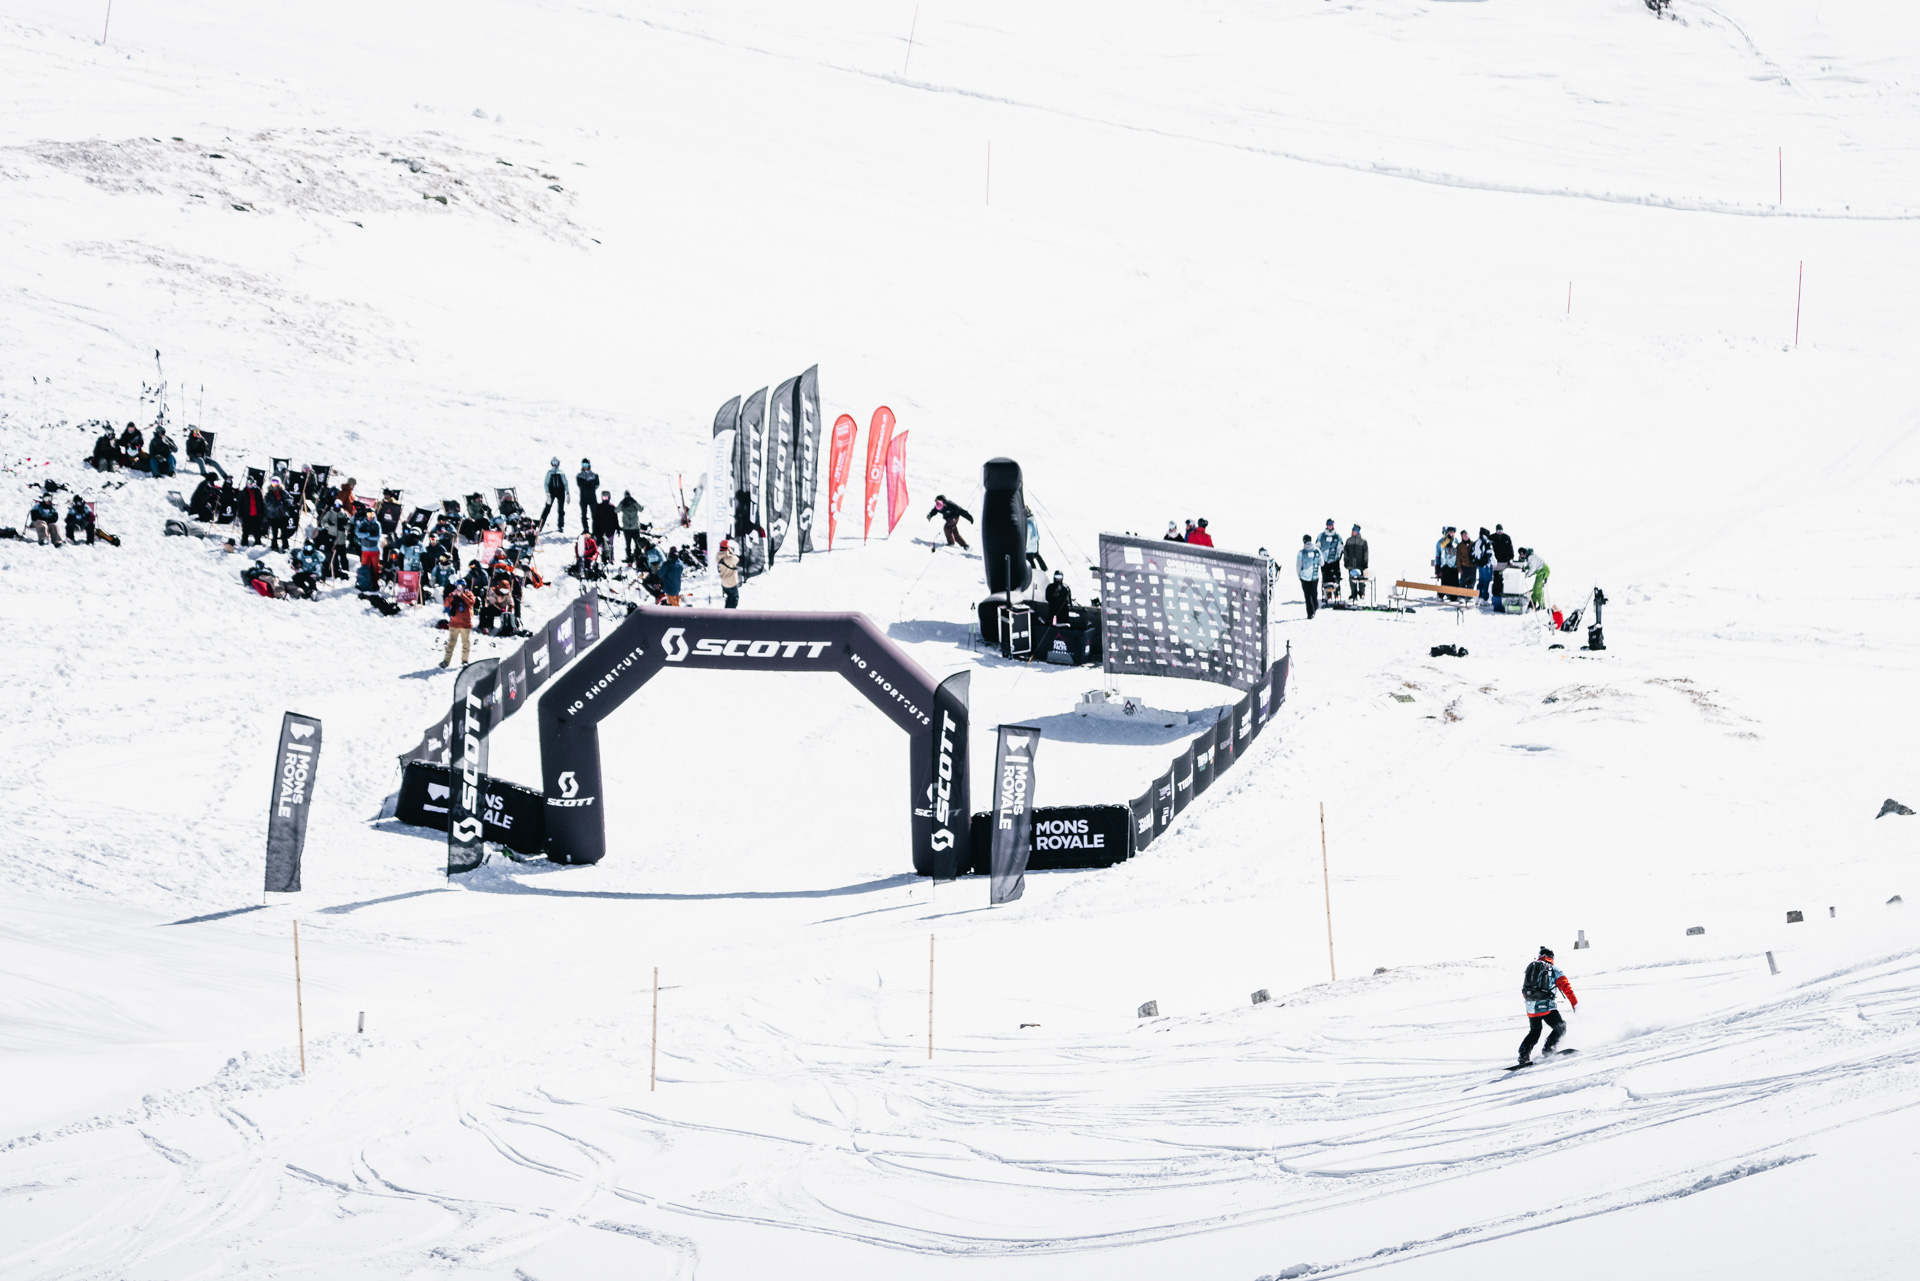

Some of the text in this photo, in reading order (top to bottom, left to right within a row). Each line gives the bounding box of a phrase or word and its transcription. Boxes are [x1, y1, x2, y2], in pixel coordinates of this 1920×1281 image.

[714, 439, 725, 482] Austria
[773, 402, 790, 513] SCOTT
[802, 392, 813, 506] SCOTT
[715, 486, 724, 497] of
[749, 423, 760, 524] SCOTT
[714, 500, 727, 525] Top
[692, 638, 833, 659] SCOTT
[850, 653, 867, 669] NO
[567, 700, 584, 716] NO
[462, 685, 482, 815] SCOTT
[936, 709, 957, 827] SCOTT
[277, 752, 298, 818] ROYALE
[292, 754, 311, 805] MONS
[546, 796, 596, 808] SCOTT
[999, 765, 1015, 830] ROYALE
[1013, 765, 1029, 816] MONS
[1036, 819, 1089, 836] MONS
[1036, 834, 1105, 851] ROYALE
